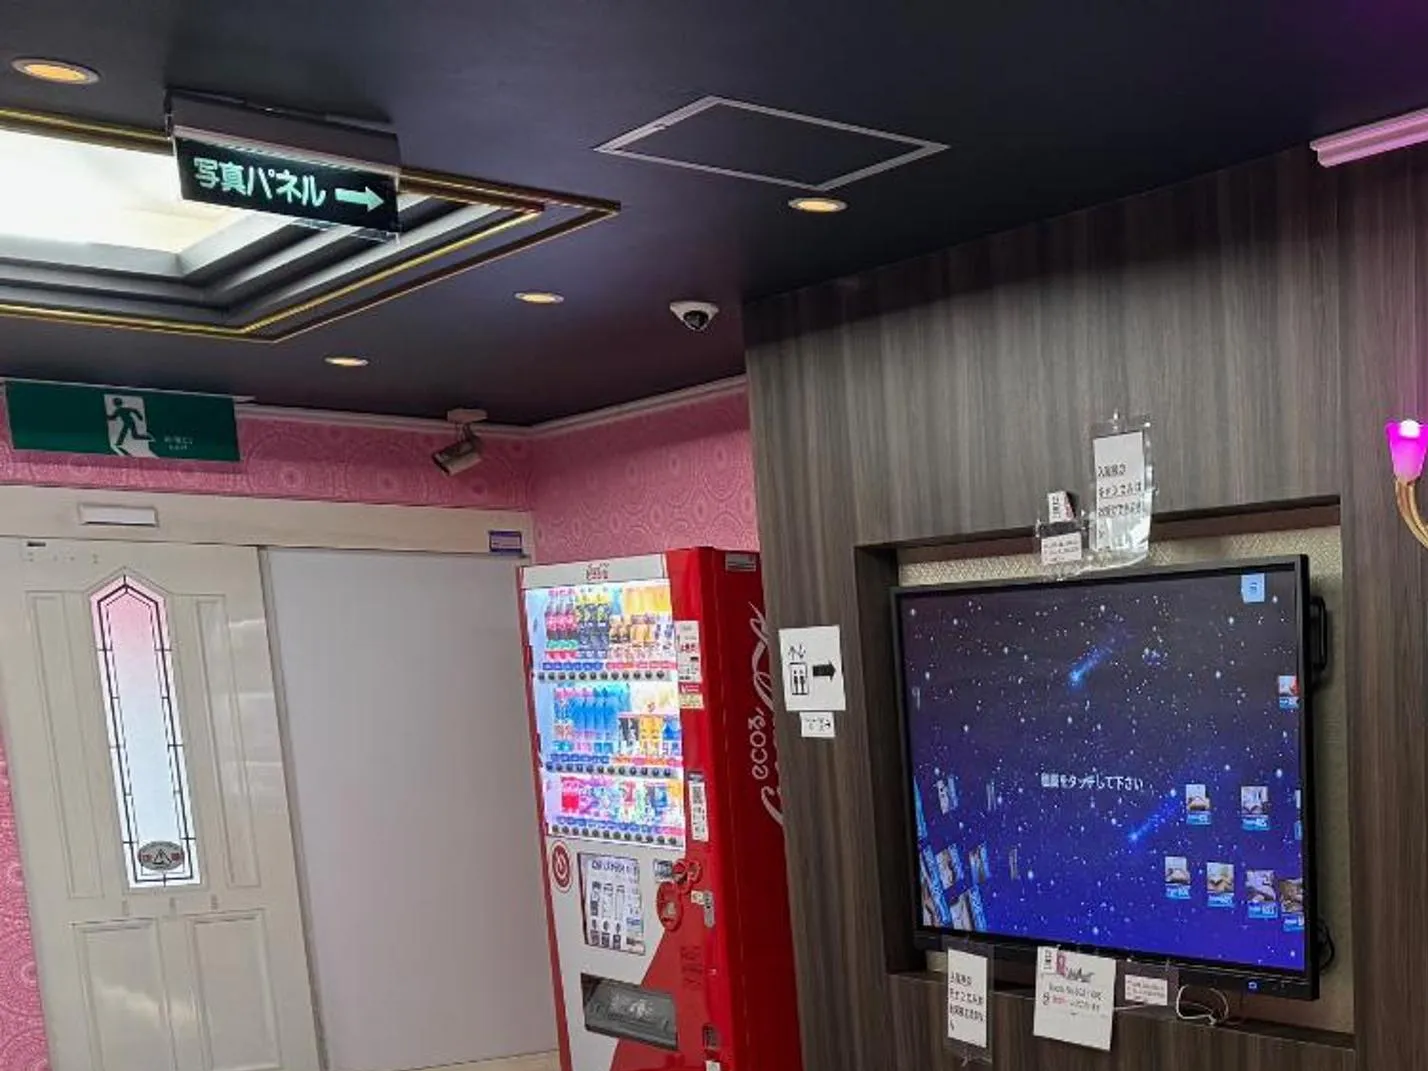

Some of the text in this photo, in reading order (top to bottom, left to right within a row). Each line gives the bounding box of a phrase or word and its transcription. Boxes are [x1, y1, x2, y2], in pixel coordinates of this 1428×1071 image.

[193, 157, 327, 207] 写真パネル
